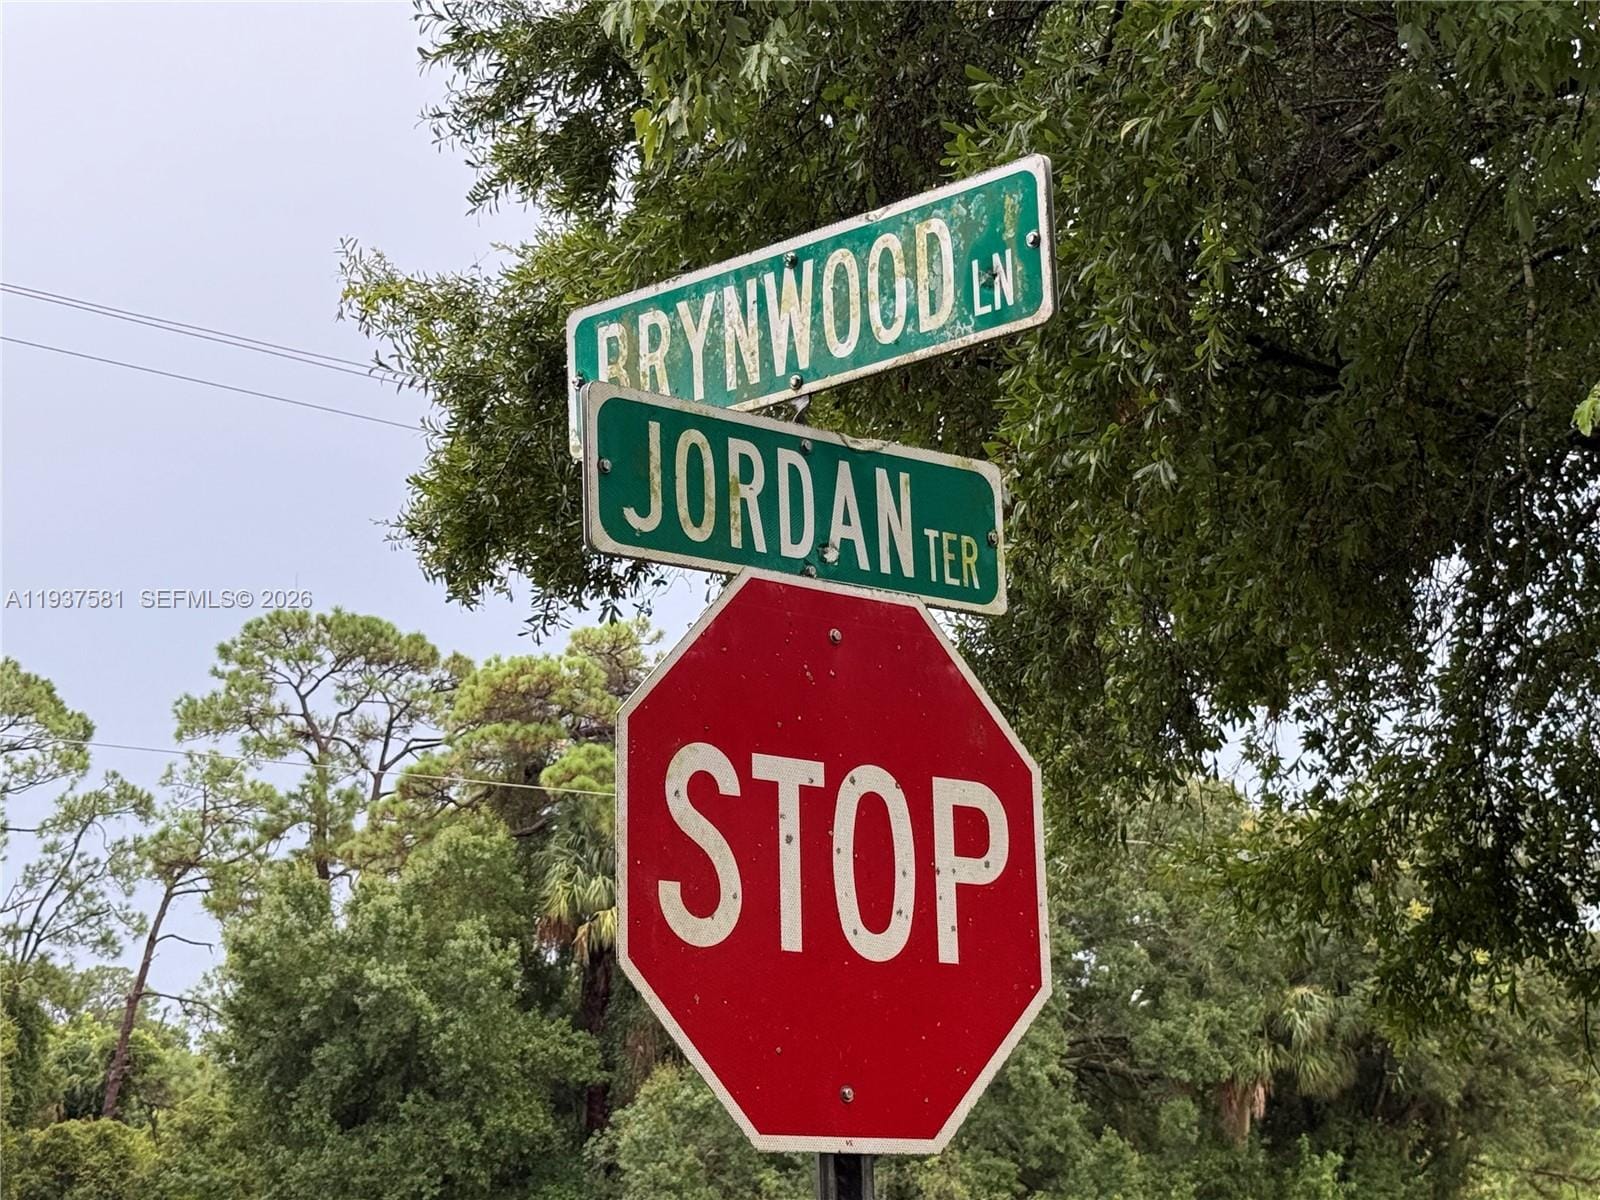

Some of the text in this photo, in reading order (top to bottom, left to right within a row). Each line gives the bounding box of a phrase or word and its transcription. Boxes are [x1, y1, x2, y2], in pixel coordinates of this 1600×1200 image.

[598, 218, 1014, 401] BRYNWOOD LN
[623, 421, 980, 590] JORDAN TER
[658, 742, 1009, 965] STOP
